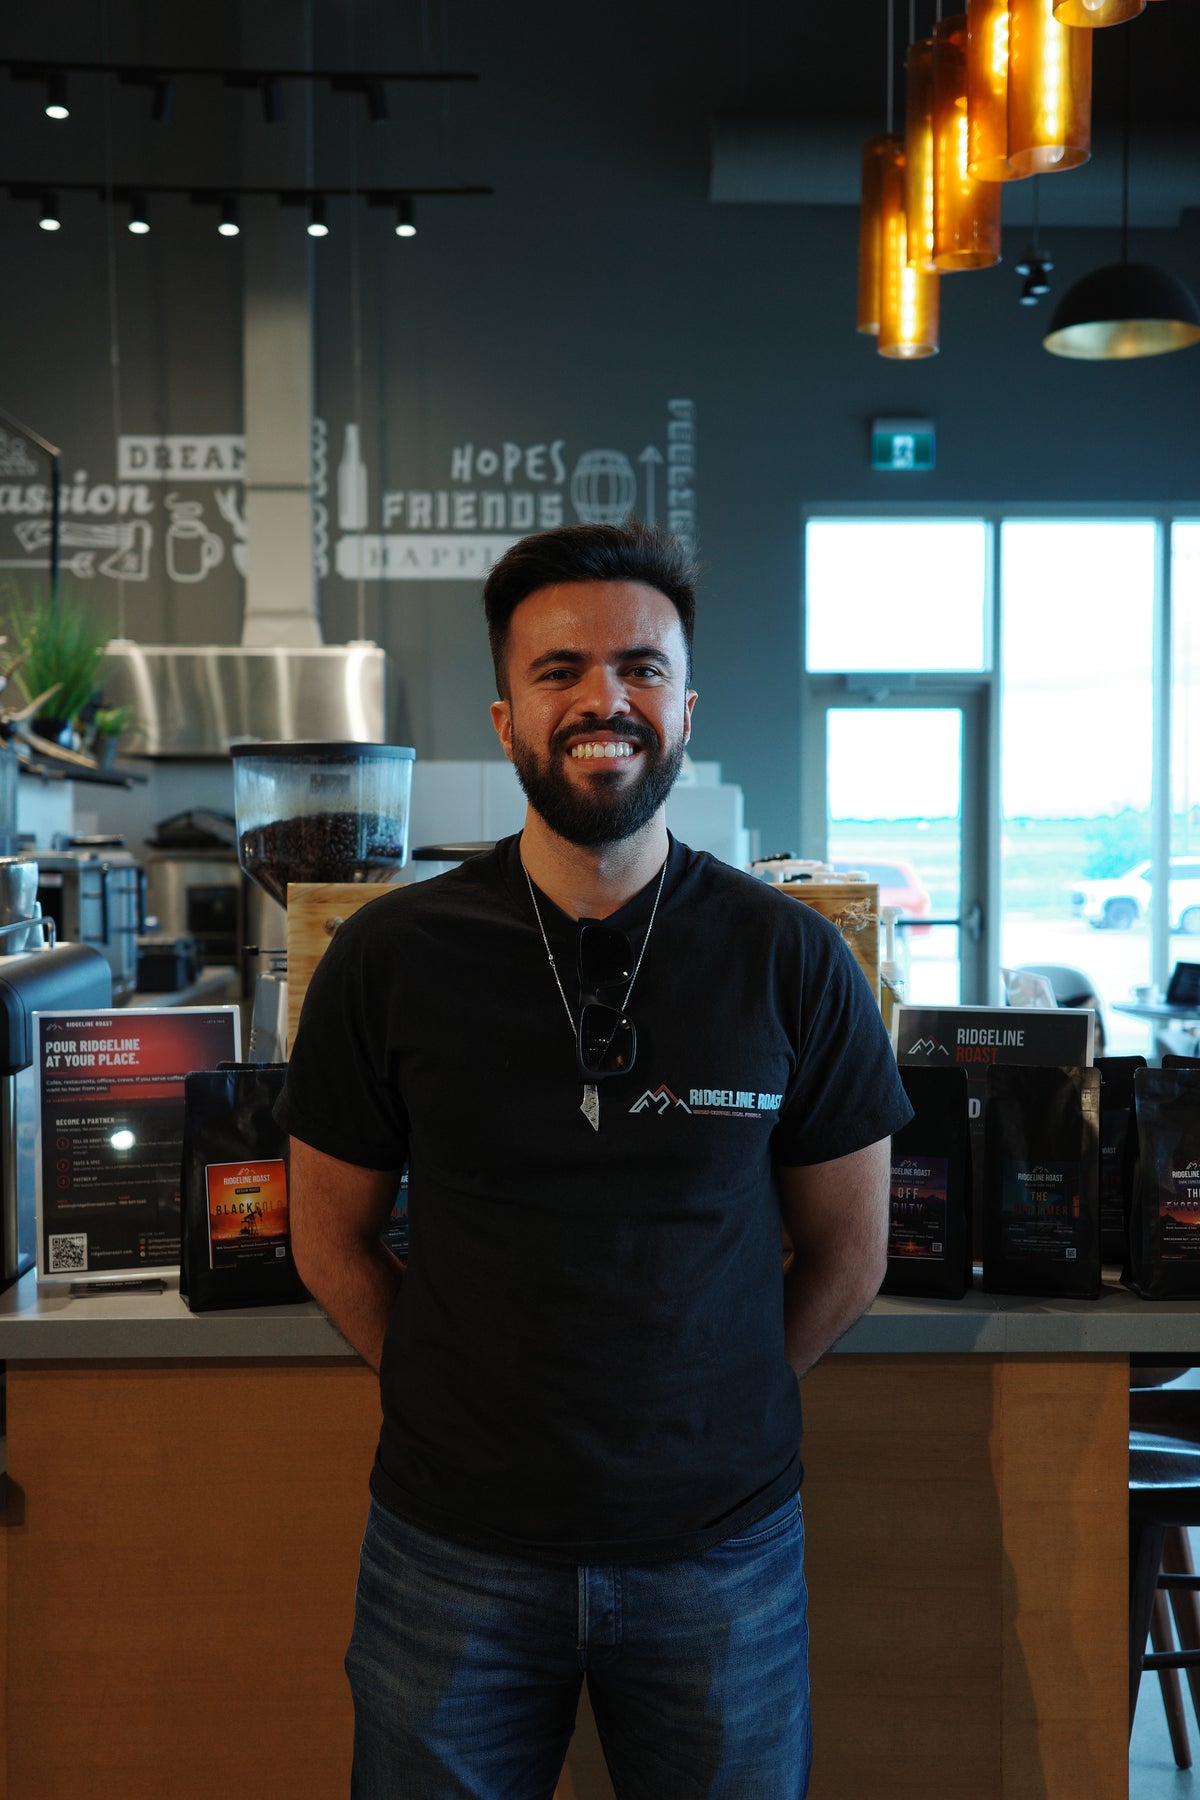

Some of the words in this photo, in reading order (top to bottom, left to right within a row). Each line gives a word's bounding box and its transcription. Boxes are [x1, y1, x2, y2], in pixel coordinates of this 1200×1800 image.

[0, 470, 152, 514] asion
[382, 491, 564, 528] FRIENDS
[368, 545, 494, 568] HAPPI
[66, 1021, 94, 1029] RIDGELINE
[957, 1028, 1025, 1047] RIDGELINE
[45, 1040, 77, 1054] POUR
[79, 1038, 140, 1053] RIDGELINE
[45, 1055, 61, 1068] AT
[64, 1054, 95, 1067] YOUR
[98, 1052, 140, 1066] PLACE.
[955, 1046, 999, 1064] ROAST
[689, 1088, 756, 1109] RIDGELINE
[757, 1092, 783, 1111] ROAST
[56, 1118, 80, 1126] BECOME
[81, 1118, 86, 1126] A
[87, 1117, 115, 1125] PARTNER
[891, 1167, 913, 1176] DGELINE
[914, 1168, 931, 1177] ROAST
[1017, 1172, 1045, 1182] RIDGELINE
[1045, 1173, 1063, 1182] ROAST
[1172, 1170, 1200, 1179] RIDGELINE
[223, 1175, 252, 1185] RIDGELINE
[252, 1174, 271, 1183] ROAST
[897, 1187, 919, 1199] OFF
[1031, 1191, 1048, 1201] THE
[1187, 1188, 1200, 1198] TH
[892, 1202, 923, 1215] DUTY
[1166, 1201, 1199, 1210] EXPER
